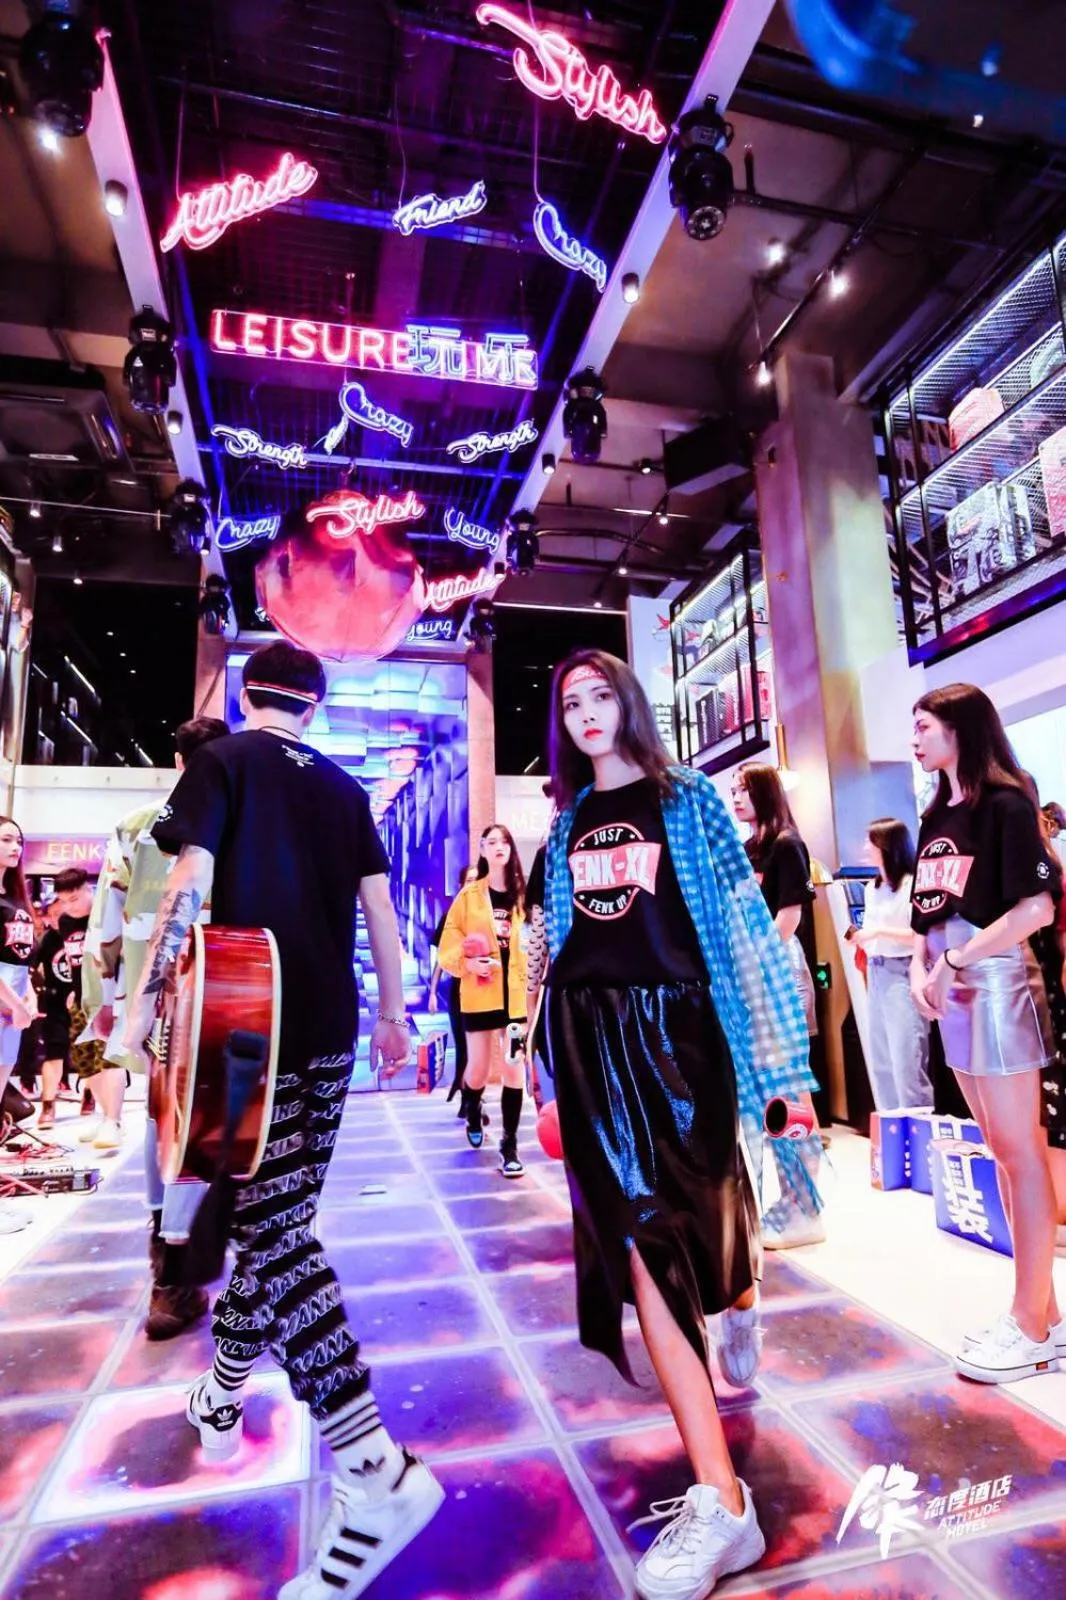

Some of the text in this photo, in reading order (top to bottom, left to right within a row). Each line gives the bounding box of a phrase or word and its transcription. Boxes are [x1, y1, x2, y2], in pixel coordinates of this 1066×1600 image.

[476, 3, 667, 144] Stylish
[160, 152, 318, 252] Attitude
[393, 179, 487, 235] Friend
[533, 201, 607, 292] Crazy
[213, 311, 413, 370] LEISURE
[339, 382, 414, 448] Crazy
[211, 424, 307, 470] Strength
[446, 418, 538, 464] Strength
[215, 515, 281, 551] Crazy
[306, 490, 424, 540] Stylish
[444, 507, 500, 553] Young
[593, 828, 624, 846] JUST
[588, 898, 616, 914] FENK
